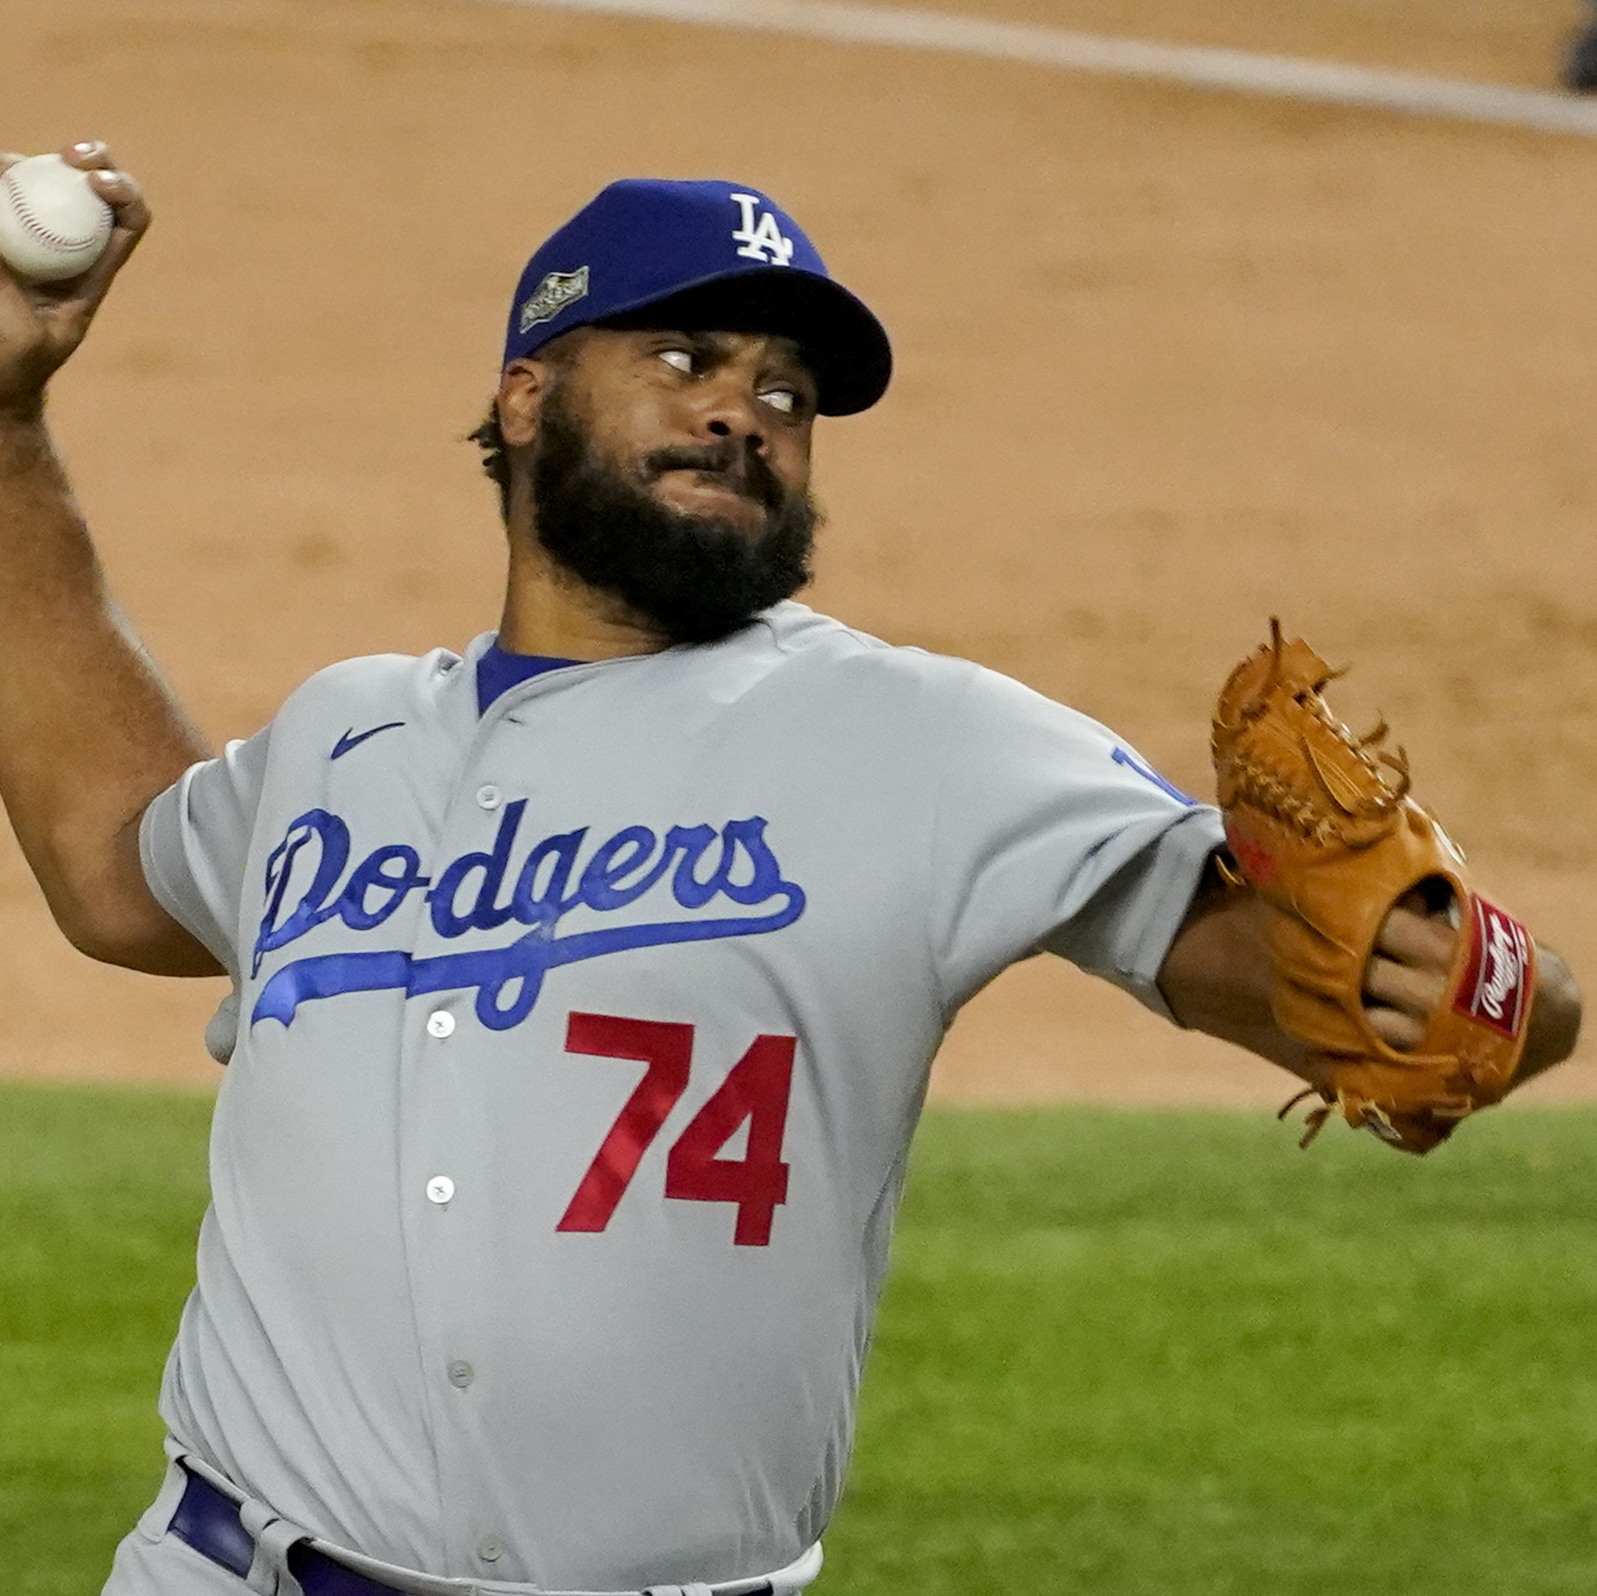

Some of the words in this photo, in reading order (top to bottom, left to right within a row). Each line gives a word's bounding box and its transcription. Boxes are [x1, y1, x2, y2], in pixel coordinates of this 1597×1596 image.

[729, 193, 793, 266] LA
[251, 798, 806, 1031] Dodgers
[555, 1011, 798, 1246] 74
